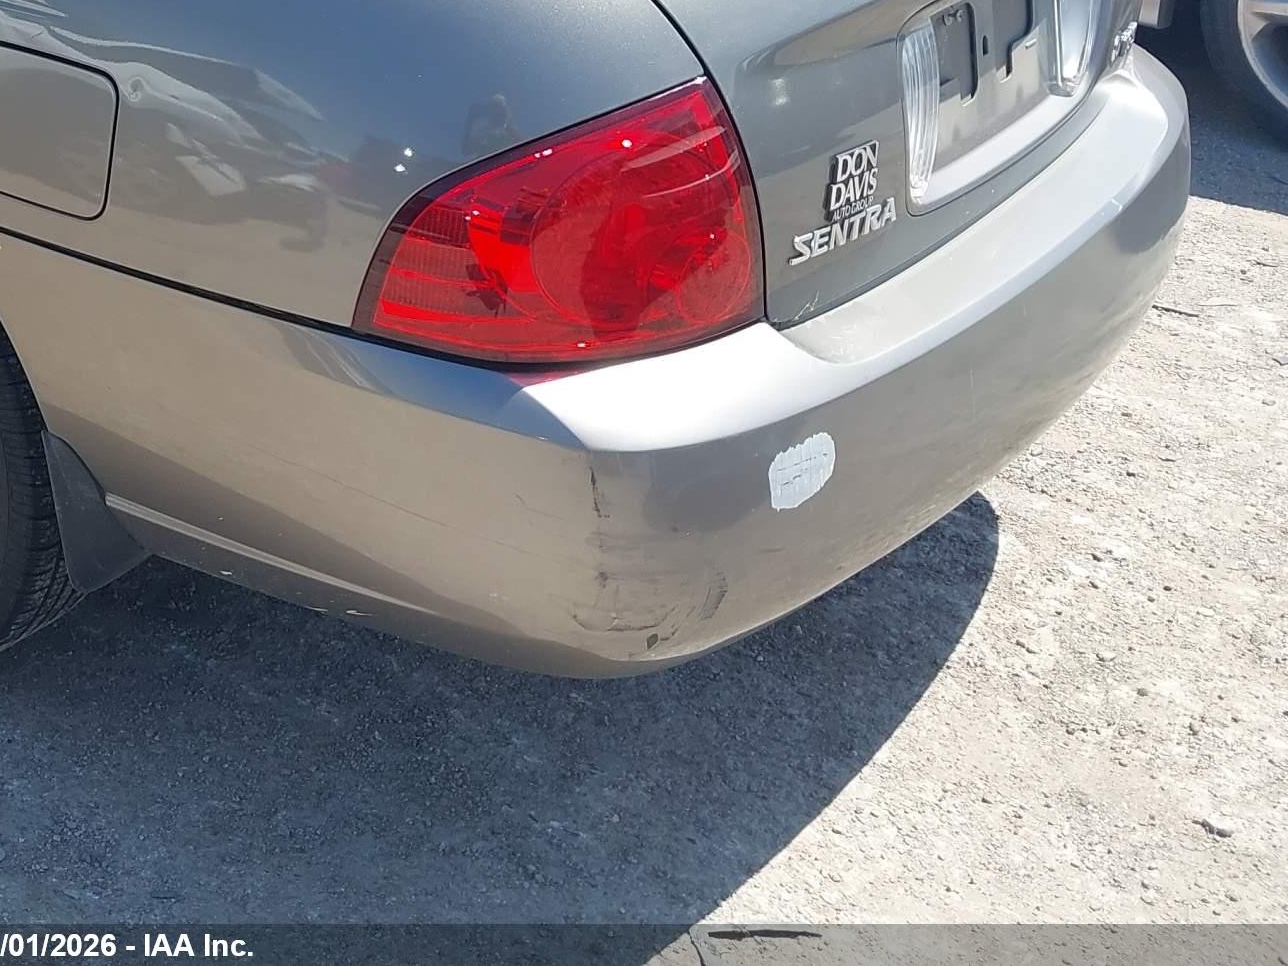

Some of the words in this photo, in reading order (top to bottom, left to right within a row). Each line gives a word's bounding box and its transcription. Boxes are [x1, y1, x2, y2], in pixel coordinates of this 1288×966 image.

[835, 144, 879, 183] DON
[829, 168, 879, 211] DAVIS
[832, 206, 852, 222] AUTO
[851, 196, 874, 215] GROUP
[788, 197, 897, 266] SENTRA
